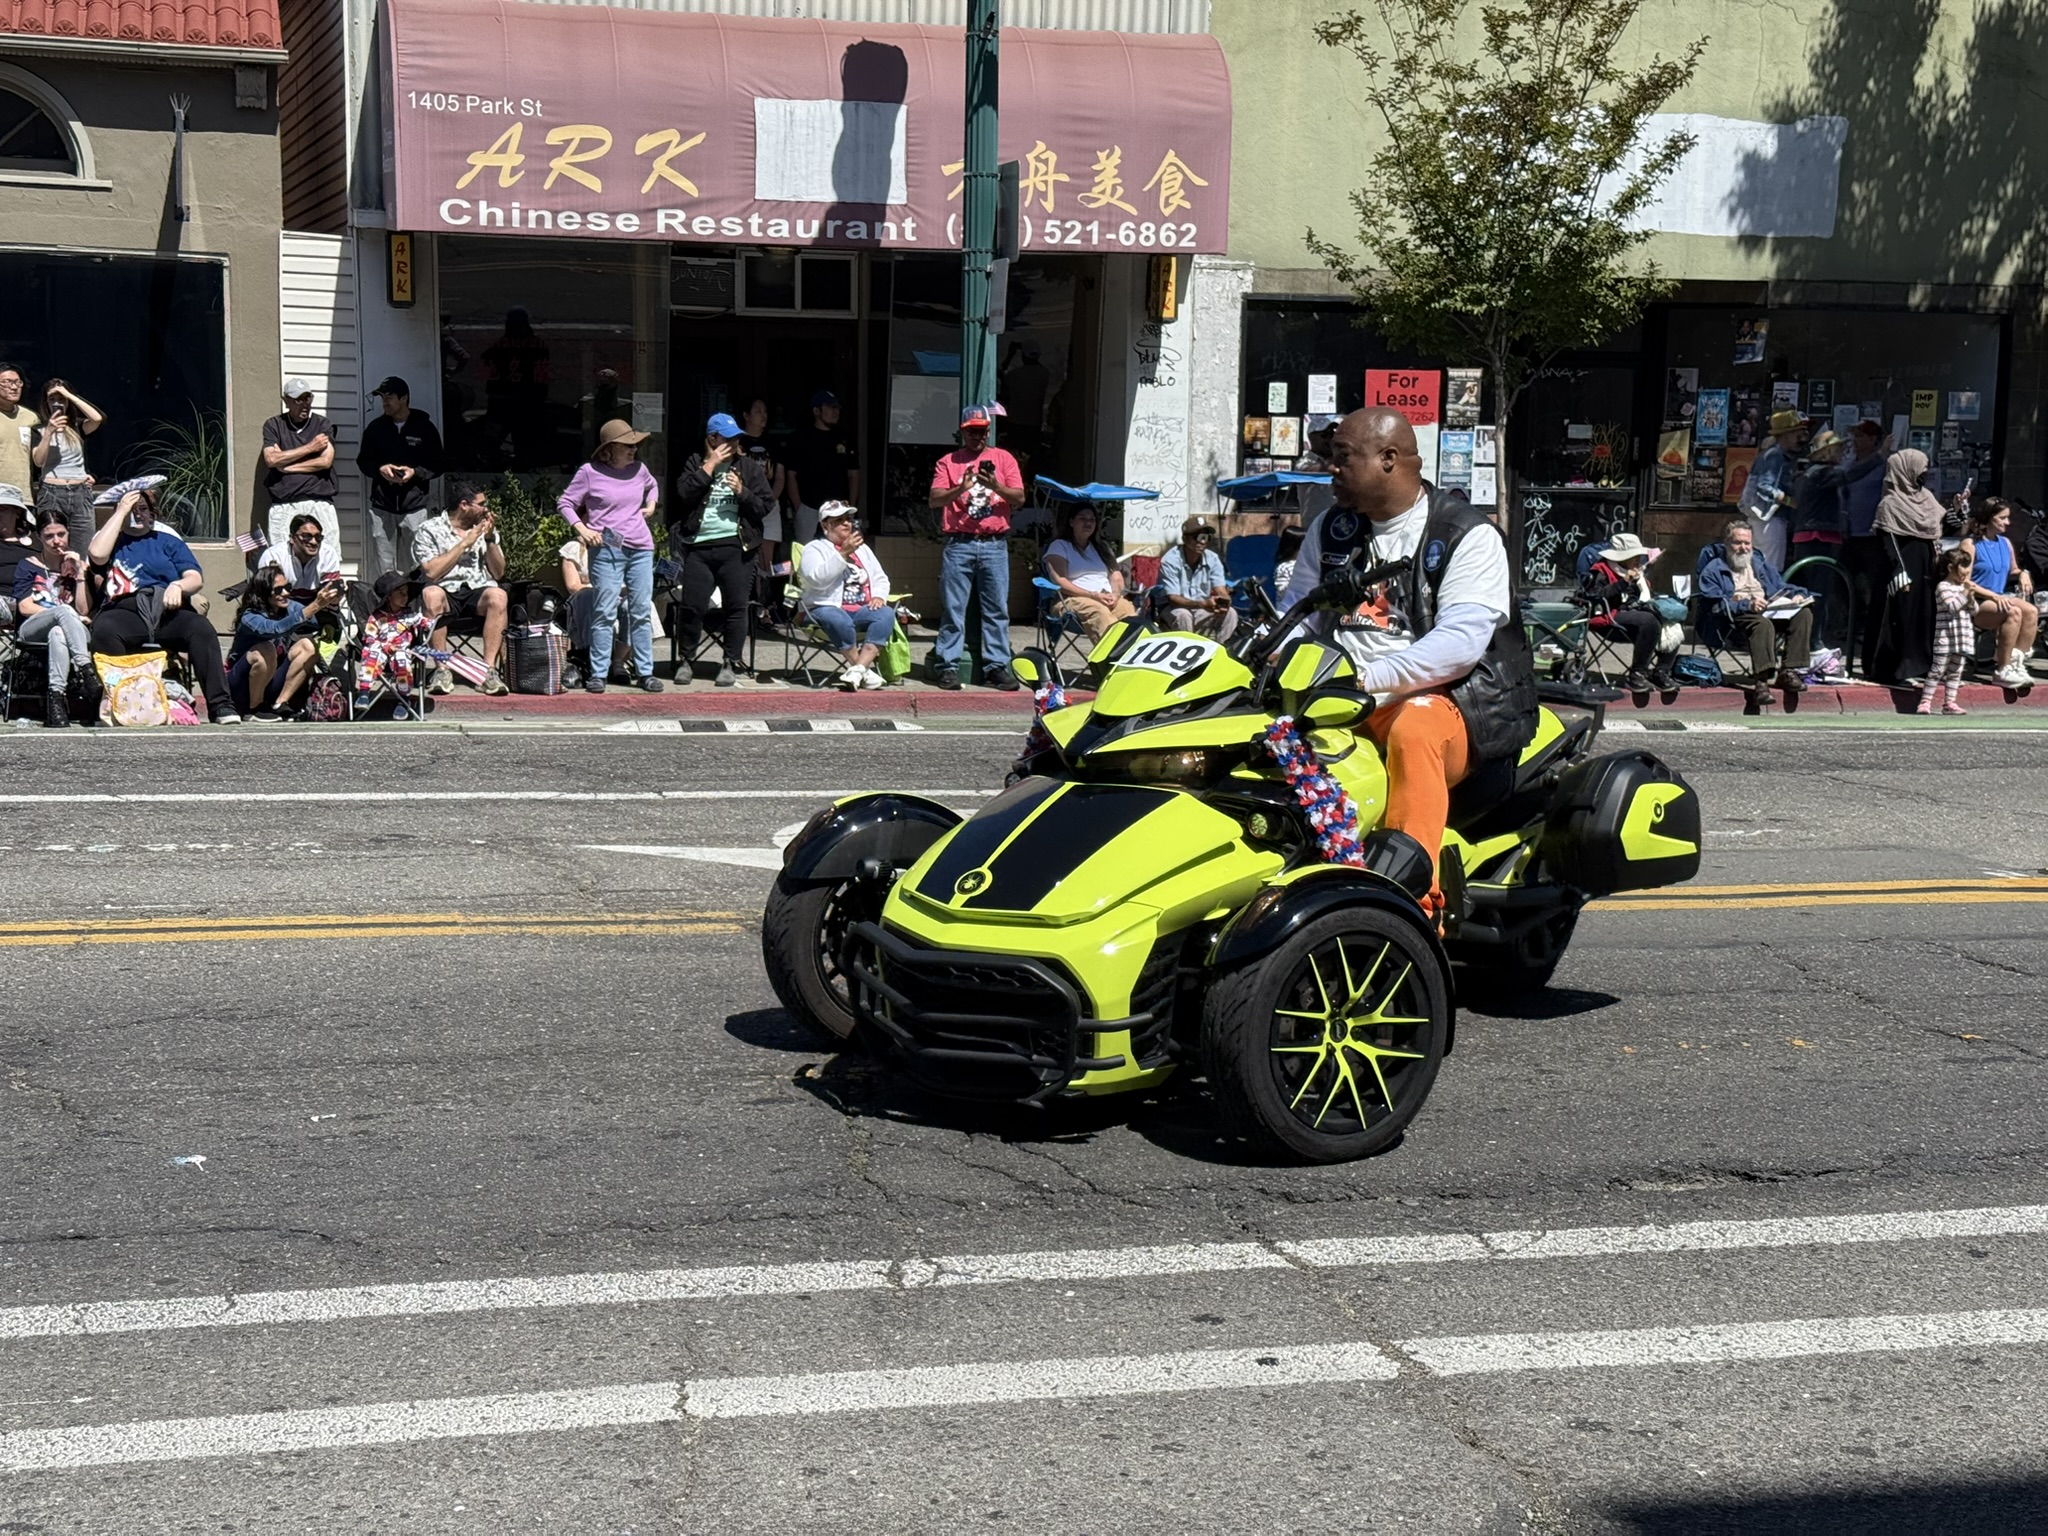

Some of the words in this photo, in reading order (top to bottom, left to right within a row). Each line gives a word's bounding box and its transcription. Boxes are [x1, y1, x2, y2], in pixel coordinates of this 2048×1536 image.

[407, 91, 460, 112] 1405
[466, 95, 515, 115] Park
[520, 98, 543, 117] St
[456, 122, 706, 198] ARK
[439, 198, 641, 233] Chinese
[656, 208, 918, 242] Restaurant
[1043, 219, 1197, 248] 521-6862
[394, 241, 409, 294] ARK
[1387, 373, 1420, 389] For
[1375, 391, 1430, 407] Lease
[1915, 393, 1934, 402] IMP
[1121, 640, 1206, 673] 109
